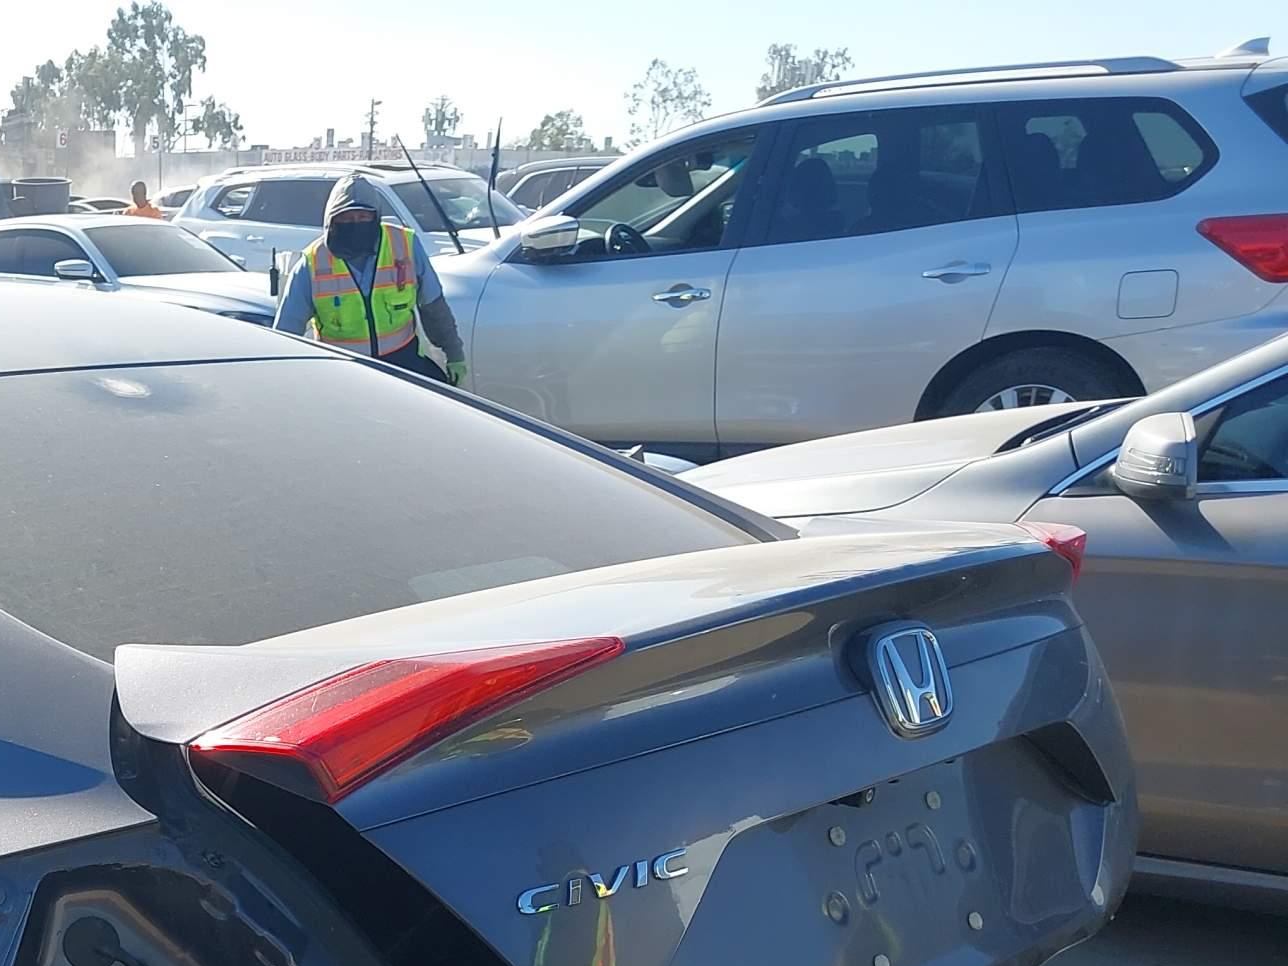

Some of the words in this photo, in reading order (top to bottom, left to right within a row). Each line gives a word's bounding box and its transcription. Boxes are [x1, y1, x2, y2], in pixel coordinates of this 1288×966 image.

[59, 132, 67, 146] 6
[152, 136, 160, 149] 5
[264, 151, 282, 163] AUTO
[517, 848, 689, 915] CIVIC
